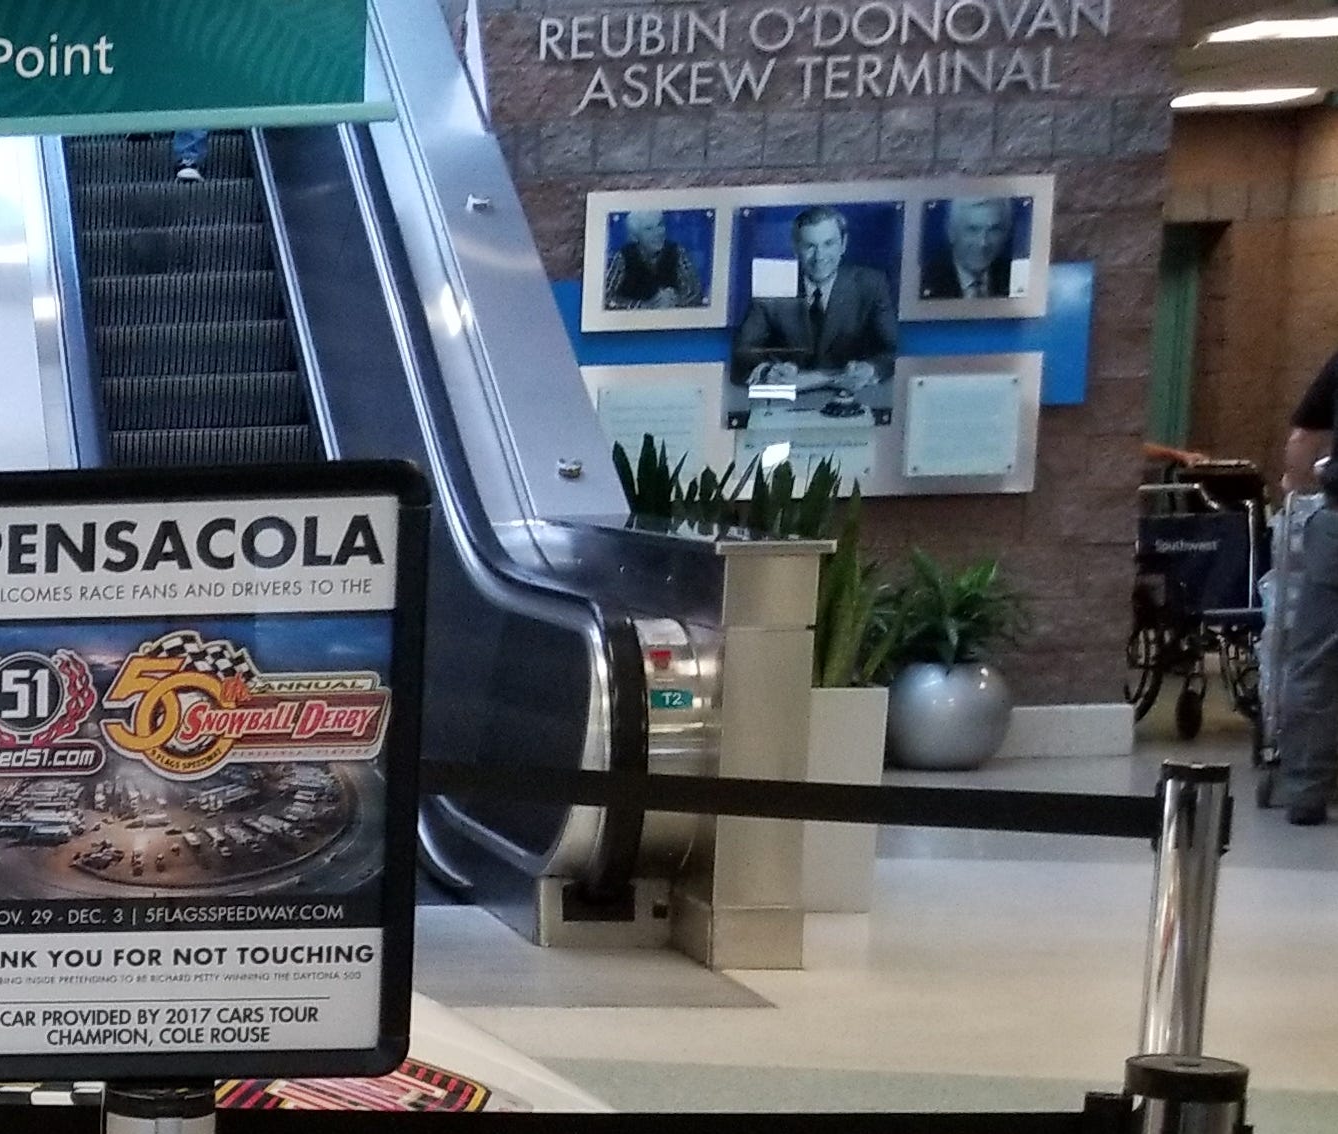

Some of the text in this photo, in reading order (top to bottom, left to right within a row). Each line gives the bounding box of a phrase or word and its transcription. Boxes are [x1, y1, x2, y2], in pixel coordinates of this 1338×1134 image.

[538, 0, 1111, 61] REUBIN O'DONOVAN
[570, 47, 1061, 116] ASKEW TERMINAL
[80, 584, 125, 601] RACE
[132, 583, 178, 599] FANS
[184, 581, 225, 598] AND
[232, 580, 302, 597] DRIVERS
[310, 579, 334, 595] TO
[340, 578, 373, 594] THE
[1, 668, 50, 719] 51
[661, 691, 685, 706] T2
[179, 701, 378, 742] SNOWBALL DERBY
[31, 909, 53, 925] 29
[67, 908, 107, 924] DEC.
[112, 907, 124, 923] 3
[144, 904, 344, 923] 5FLAGSSPEEDWAY.COM
[48, 950, 103, 967] YOU
[113, 949, 163, 967] FOR
[173, 948, 228, 965] NOT
[236, 945, 375, 964] TOUCHING
[25, 975, 55, 984] INSIDE
[58, 974, 117, 984] PRETENDING
[151, 973, 191, 983] RICHARD
[193, 973, 220, 982] PETTY
[273, 972, 289, 981] THE
[292, 971, 340, 980] DAYTONA
[343, 971, 361, 980] 500
[0, 1006, 319, 1027] CAR PROVIDED BY 2017 CARS TOUR
[46, 1026, 270, 1047] CHAMPION, COLE ROUSE
